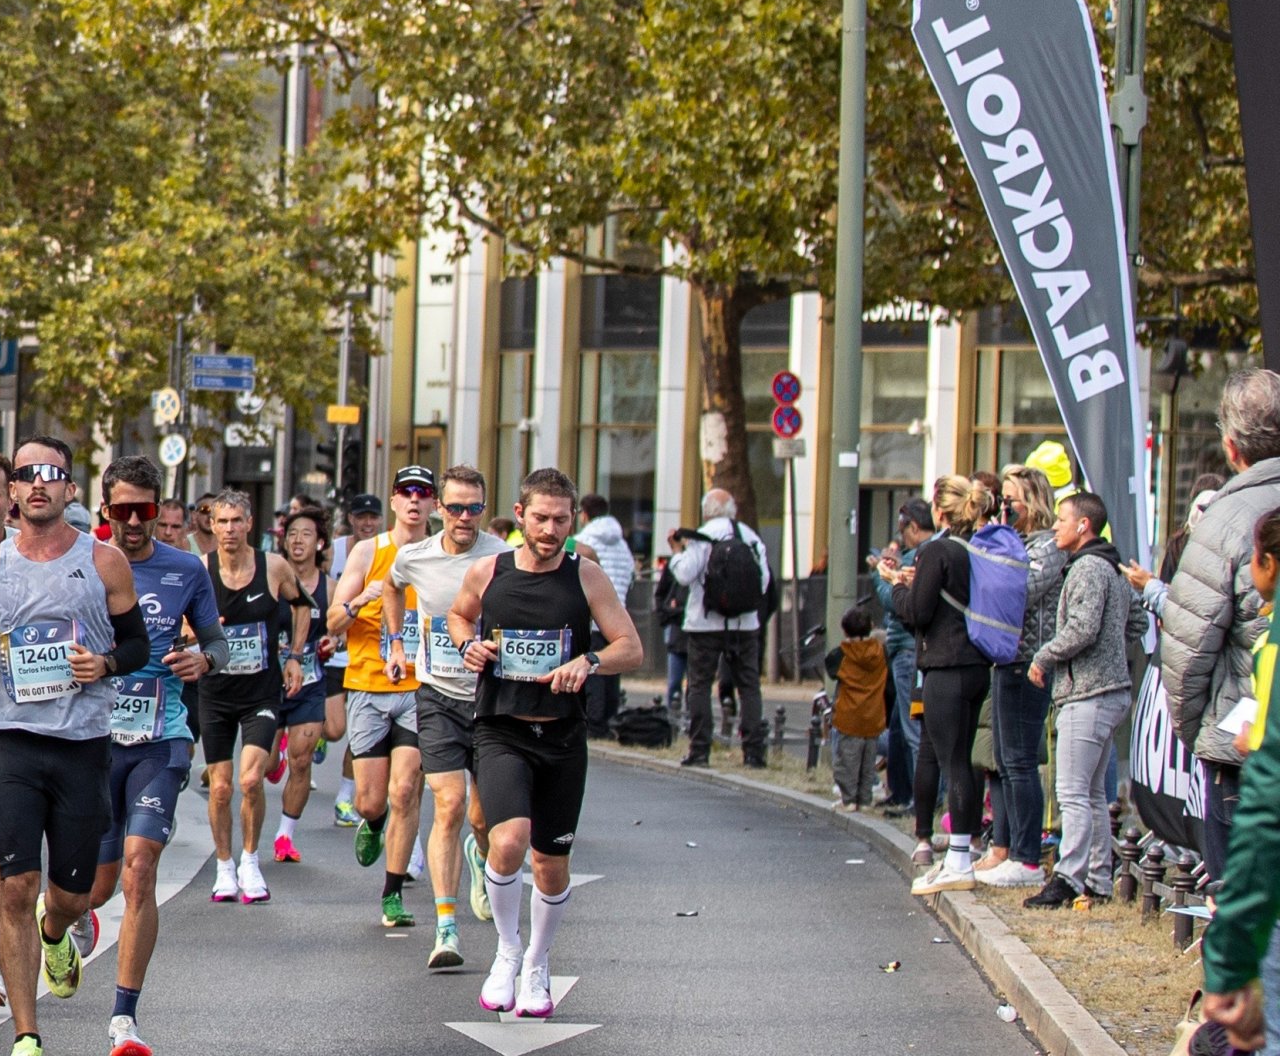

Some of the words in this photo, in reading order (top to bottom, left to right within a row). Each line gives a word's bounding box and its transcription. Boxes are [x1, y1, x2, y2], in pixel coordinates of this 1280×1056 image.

[18, 645, 67, 665] 12401
[505, 641, 557, 656] 66628
[17, 687, 31, 698] YOU
[32, 686, 49, 696] GOT
[49, 684, 63, 695] THIS
[120, 733, 135, 742] THIS
